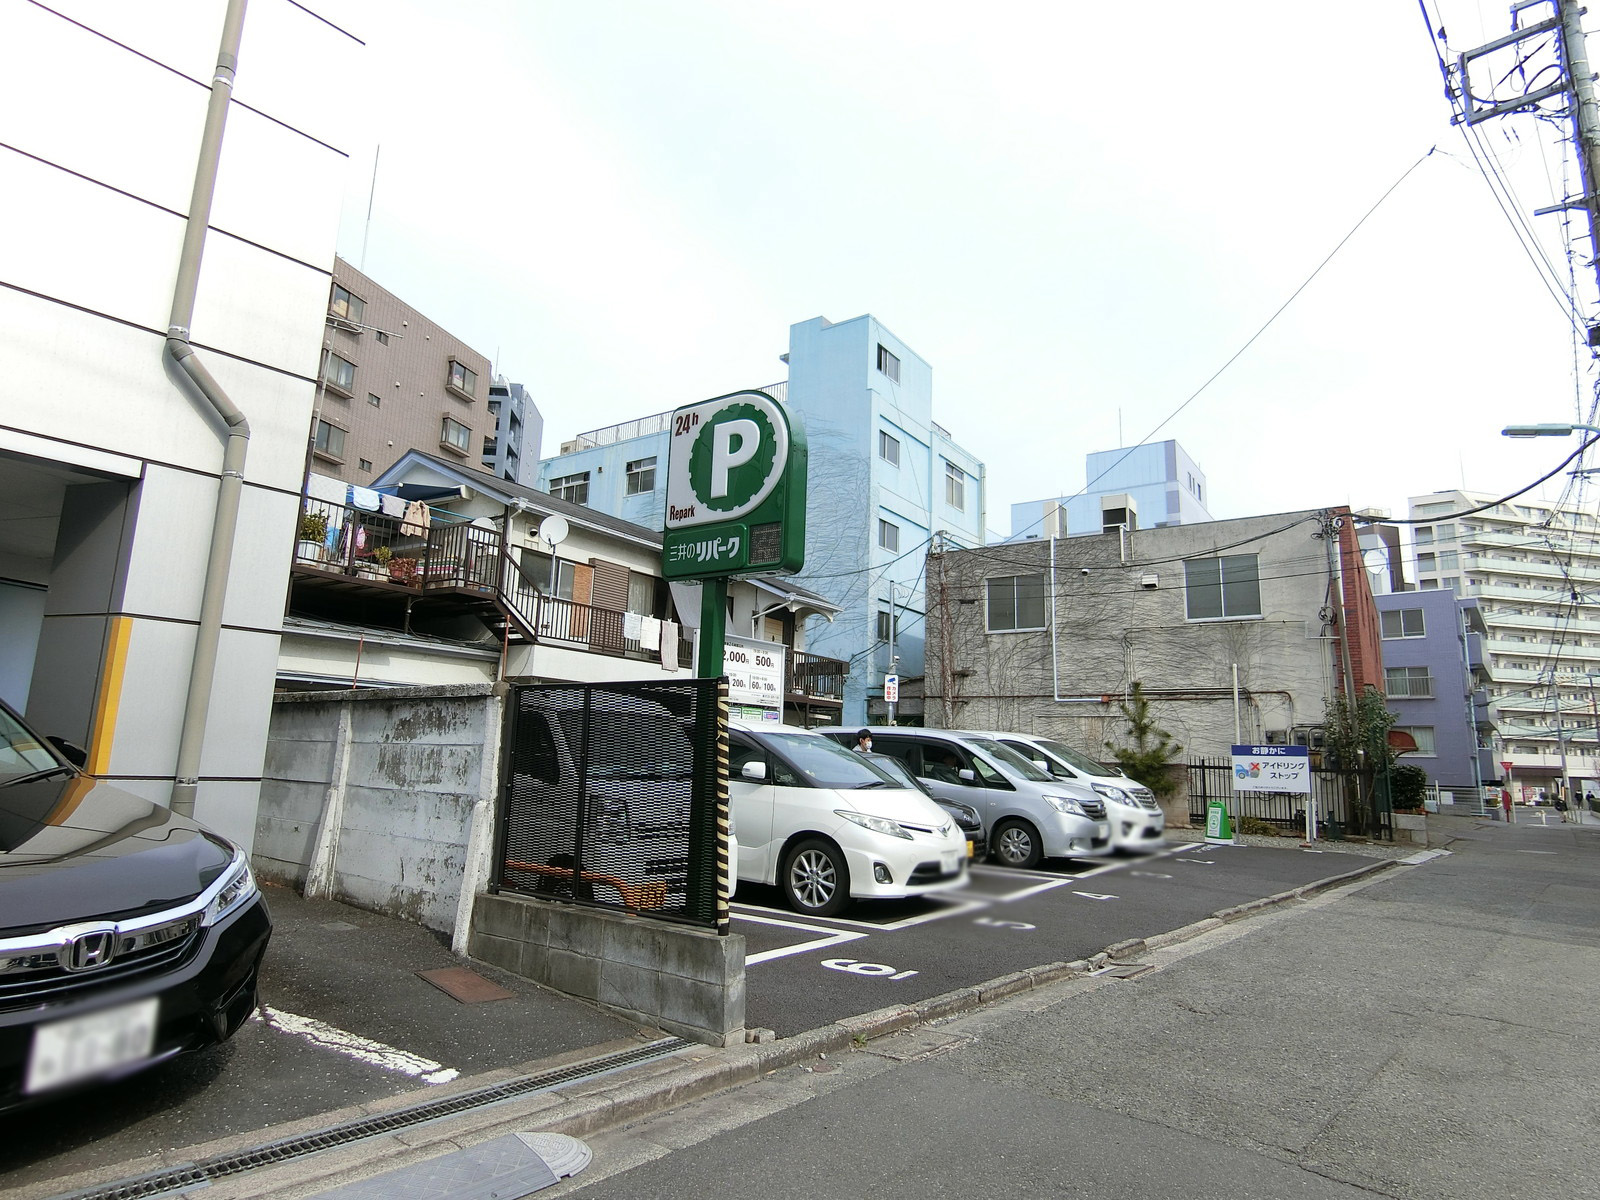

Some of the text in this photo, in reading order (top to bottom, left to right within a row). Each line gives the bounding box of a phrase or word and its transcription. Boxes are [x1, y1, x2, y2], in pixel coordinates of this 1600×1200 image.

[675, 412, 699, 437] 24h
[711, 419, 760, 499] P
[669, 505, 696, 522] Repark
[669, 536, 740, 563] 三井のリパーク
[1252, 747, 1286, 755] お静かに
[1262, 761, 1306, 770] アイドリング
[1270, 772, 1299, 780] ストップ
